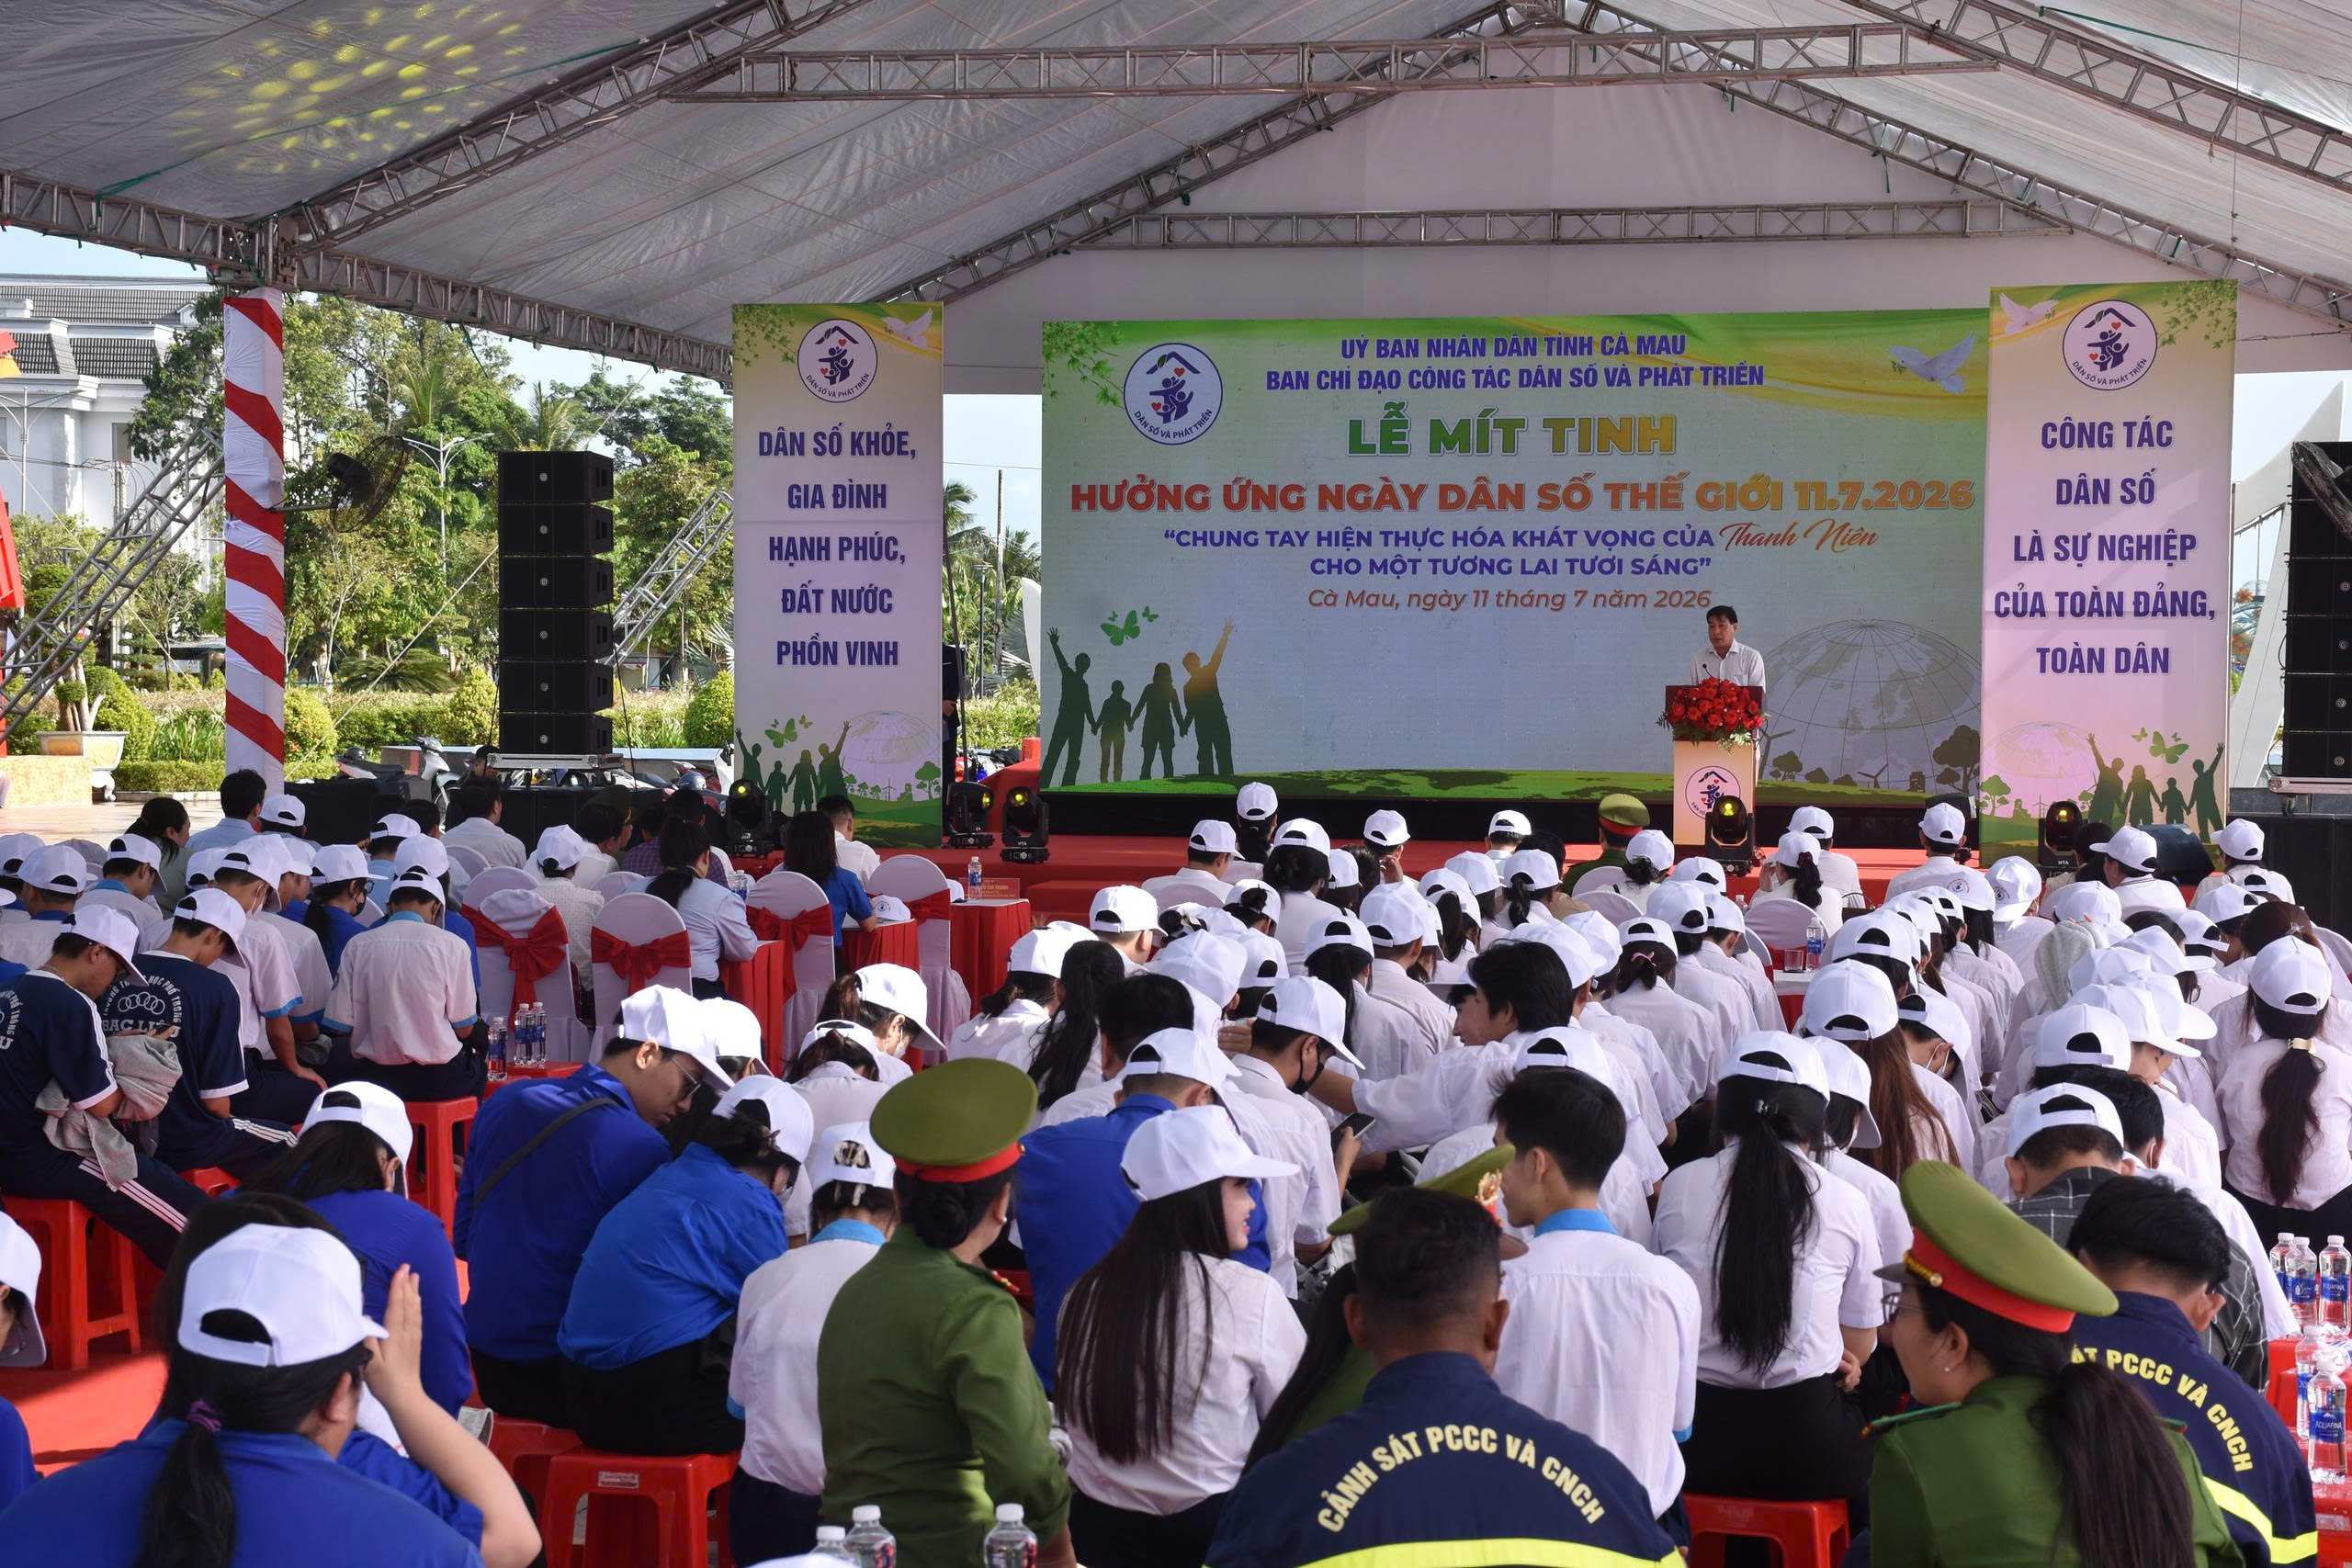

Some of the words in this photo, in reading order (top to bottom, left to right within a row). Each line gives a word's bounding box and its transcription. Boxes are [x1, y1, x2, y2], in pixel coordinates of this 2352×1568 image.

[1341, 333, 1369, 358] UỶ
[1376, 338, 1419, 357] BAN
[1427, 333, 1487, 357] NHÂN
[1494, 333, 1537, 356] DÂN
[1544, 331, 1592, 356] TỈNH
[1600, 332, 1630, 355] CÀ
[1636, 335, 1686, 355] MAU
[806, 375, 819, 389] DÂN
[1266, 370, 1309, 390] BAN
[1317, 367, 1351, 390] CHỈ
[1357, 369, 1401, 394] ĐẠO
[1408, 367, 1466, 390] CÔNG
[1473, 365, 1510, 389] TÁC
[1519, 366, 1563, 389] DÂN
[1570, 363, 1598, 388] SỐ
[1604, 365, 1632, 388] VÀ
[1638, 364, 1695, 387] PHÁT
[1700, 360, 1764, 386] TRIỂN
[2073, 361, 2086, 376] DÂN
[2109, 375, 2129, 385] PHÁT
[758, 424, 805, 457] DÂN
[813, 422, 844, 457] SỐ
[850, 422, 916, 460] KHỎE,
[1134, 411, 1149, 428] DÂN
[1148, 425, 1160, 435] SỐ
[1160, 430, 1171, 439] VÀ
[1172, 426, 1193, 439] PHÁT
[1347, 400, 1411, 456] LỄ
[1429, 407, 1526, 456] MÍT
[1542, 414, 1678, 456] TINH
[2041, 416, 2113, 448] CÔNG
[2122, 415, 2174, 448] TÁC
[787, 484, 825, 510] GIA
[831, 479, 887, 509] ĐÌNH
[1071, 473, 1211, 513] HƯỞNG
[1223, 477, 1306, 513] ỨNG
[1318, 476, 1427, 512] NGÀY
[1438, 475, 1525, 512] DÂN
[1537, 472, 1595, 512] SỐ
[1603, 471, 1690, 512] THẾ
[1695, 473, 1783, 511] GIỚI
[1794, 480, 1975, 511] 11.7.2026
[2056, 473, 2110, 505] DÂN
[2120, 468, 2157, 504] SỐ
[768, 536, 831, 568] HẠNH
[837, 530, 906, 565] PHÚC,
[1268, 530, 1309, 548] TAY
[1317, 525, 1372, 551] HIỆN
[1380, 525, 1445, 551] THỰC
[1451, 525, 1505, 547] HÓA
[1512, 525, 1578, 547] KHÁT
[1584, 529, 1655, 552] VỌNG
[1662, 524, 1714, 547] CỦA
[1720, 522, 1799, 551] Thanh
[1804, 518, 1879, 553] Niên
[2014, 530, 2044, 562] LÀ
[2053, 532, 2093, 568] SỰ
[2098, 529, 2197, 567] NGHIỆP
[1310, 558, 1362, 576] CHO
[1368, 554, 1422, 579] MỘT
[1428, 555, 1512, 576] TƯƠNG
[1521, 558, 1557, 576] LAI
[1565, 555, 1623, 576] TƯƠI
[781, 579, 823, 615] ĐẤT
[831, 582, 893, 614] NƯỚC
[1308, 589, 1340, 608] Cà
[1345, 589, 1399, 611] Mau,
[1408, 589, 1466, 612] ngày
[1473, 590, 1488, 607] 11
[1495, 586, 1565, 612] tháng
[1573, 591, 1585, 607] 7
[1592, 589, 1647, 608] năm
[1654, 589, 1711, 608] 2026
[1994, 582, 2047, 618] CỦA
[2055, 584, 2124, 618] TOÀN
[2132, 581, 2216, 620] ĐẢNG,
[776, 632, 838, 667] PHỒN
[845, 640, 899, 666] VINH
[2036, 642, 2105, 674] TOÀN
[2113, 642, 2169, 674] DÂN
[149, 976, 164, 986] HỌC
[2106, 1348, 2173, 1386] PCCC
[2177, 1374, 2208, 1408] VÀ
[2207, 1404, 2254, 1472] CNCH
[1317, 1461, 1377, 1533] CẢNH
[1372, 1432, 1423, 1472] SÁT
[1425, 1424, 1498, 1454] PCCC
[1506, 1433, 1536, 1469] VÀ
[1542, 1456, 1605, 1525] CNCH
